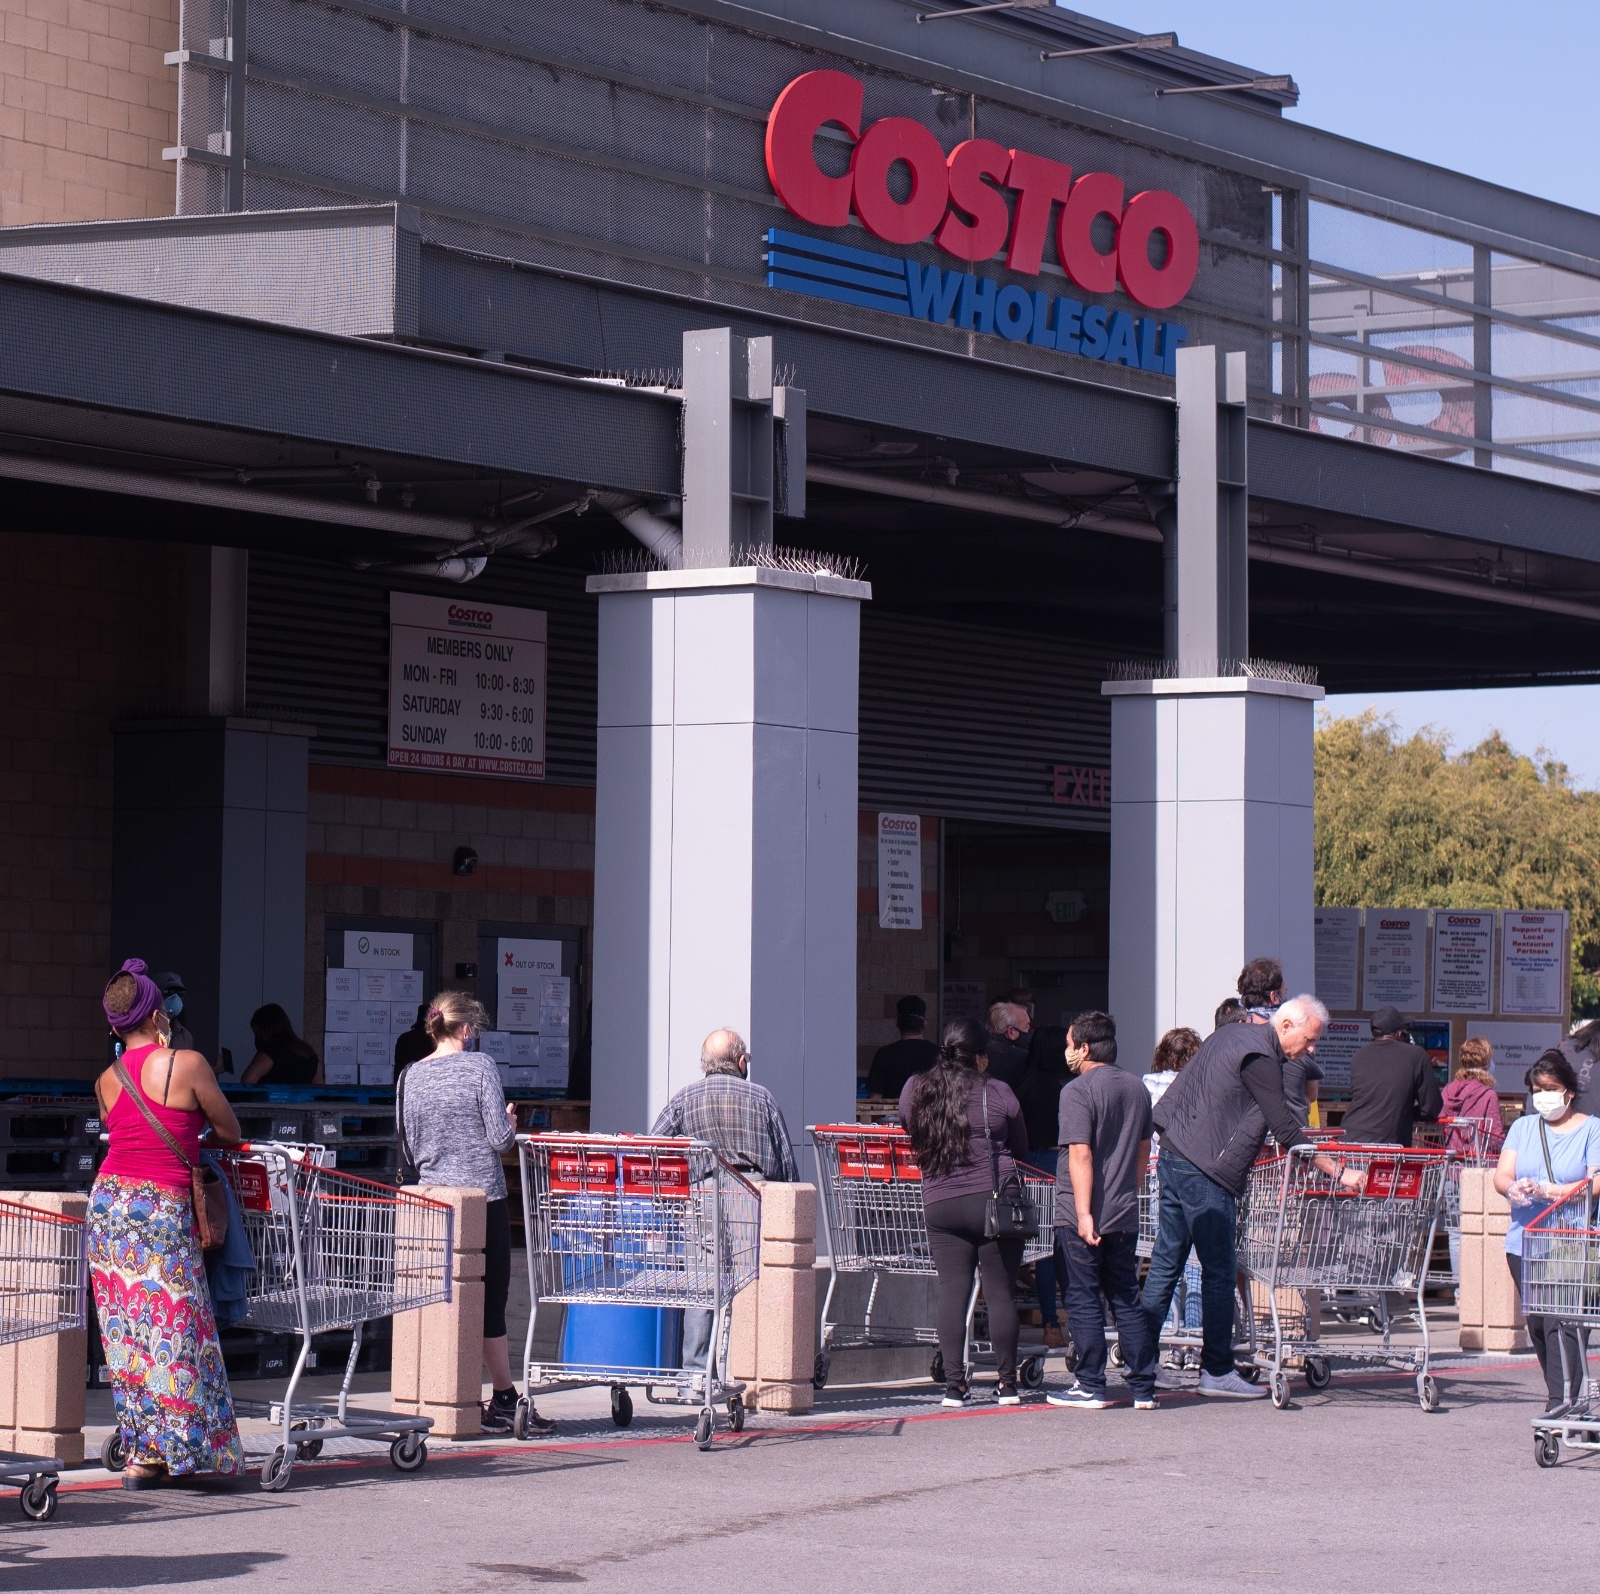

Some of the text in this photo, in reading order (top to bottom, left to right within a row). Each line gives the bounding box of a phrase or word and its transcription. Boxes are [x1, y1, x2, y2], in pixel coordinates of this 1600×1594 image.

[765, 69, 1199, 309] COSTCO
[448, 604, 493, 623] COSTCO
[461, 621, 492, 630] WHOLESALE
[427, 637, 514, 662] MEMBERS ONLY
[403, 664, 429, 683] MON
[440, 668, 457, 686] FRI
[475, 672, 504, 691] 10:00
[513, 677, 535, 695] 8:30
[402, 694, 461, 716] SATURDAY
[480, 703, 503, 721] 9:30
[512, 706, 534, 724] 6:00
[402, 724, 447, 745] SUNDAY
[474, 732, 502, 751] 10:00
[511, 736, 533, 754] 6:00
[390, 750, 543, 775] OPEN 24 HOURS A DAY AT WWW.COSTCO.COM
[1053, 764, 1111, 808] EXIT
[882, 817, 918, 831] COSTCO
[1056, 902, 1076, 920] EXIT
[1447, 916, 1481, 924] COSTCO
[1511, 926, 1541, 934] Support
[372, 948, 401, 957] IN STOCK
[515, 961, 555, 970] OUT OF STOCK
[1327, 1023, 1359, 1031] COSTCO
[1524, 1044, 1542, 1052] Mayor
[278, 1126, 297, 1135] iGPS
[266, 1360, 283, 1368] iGPS
